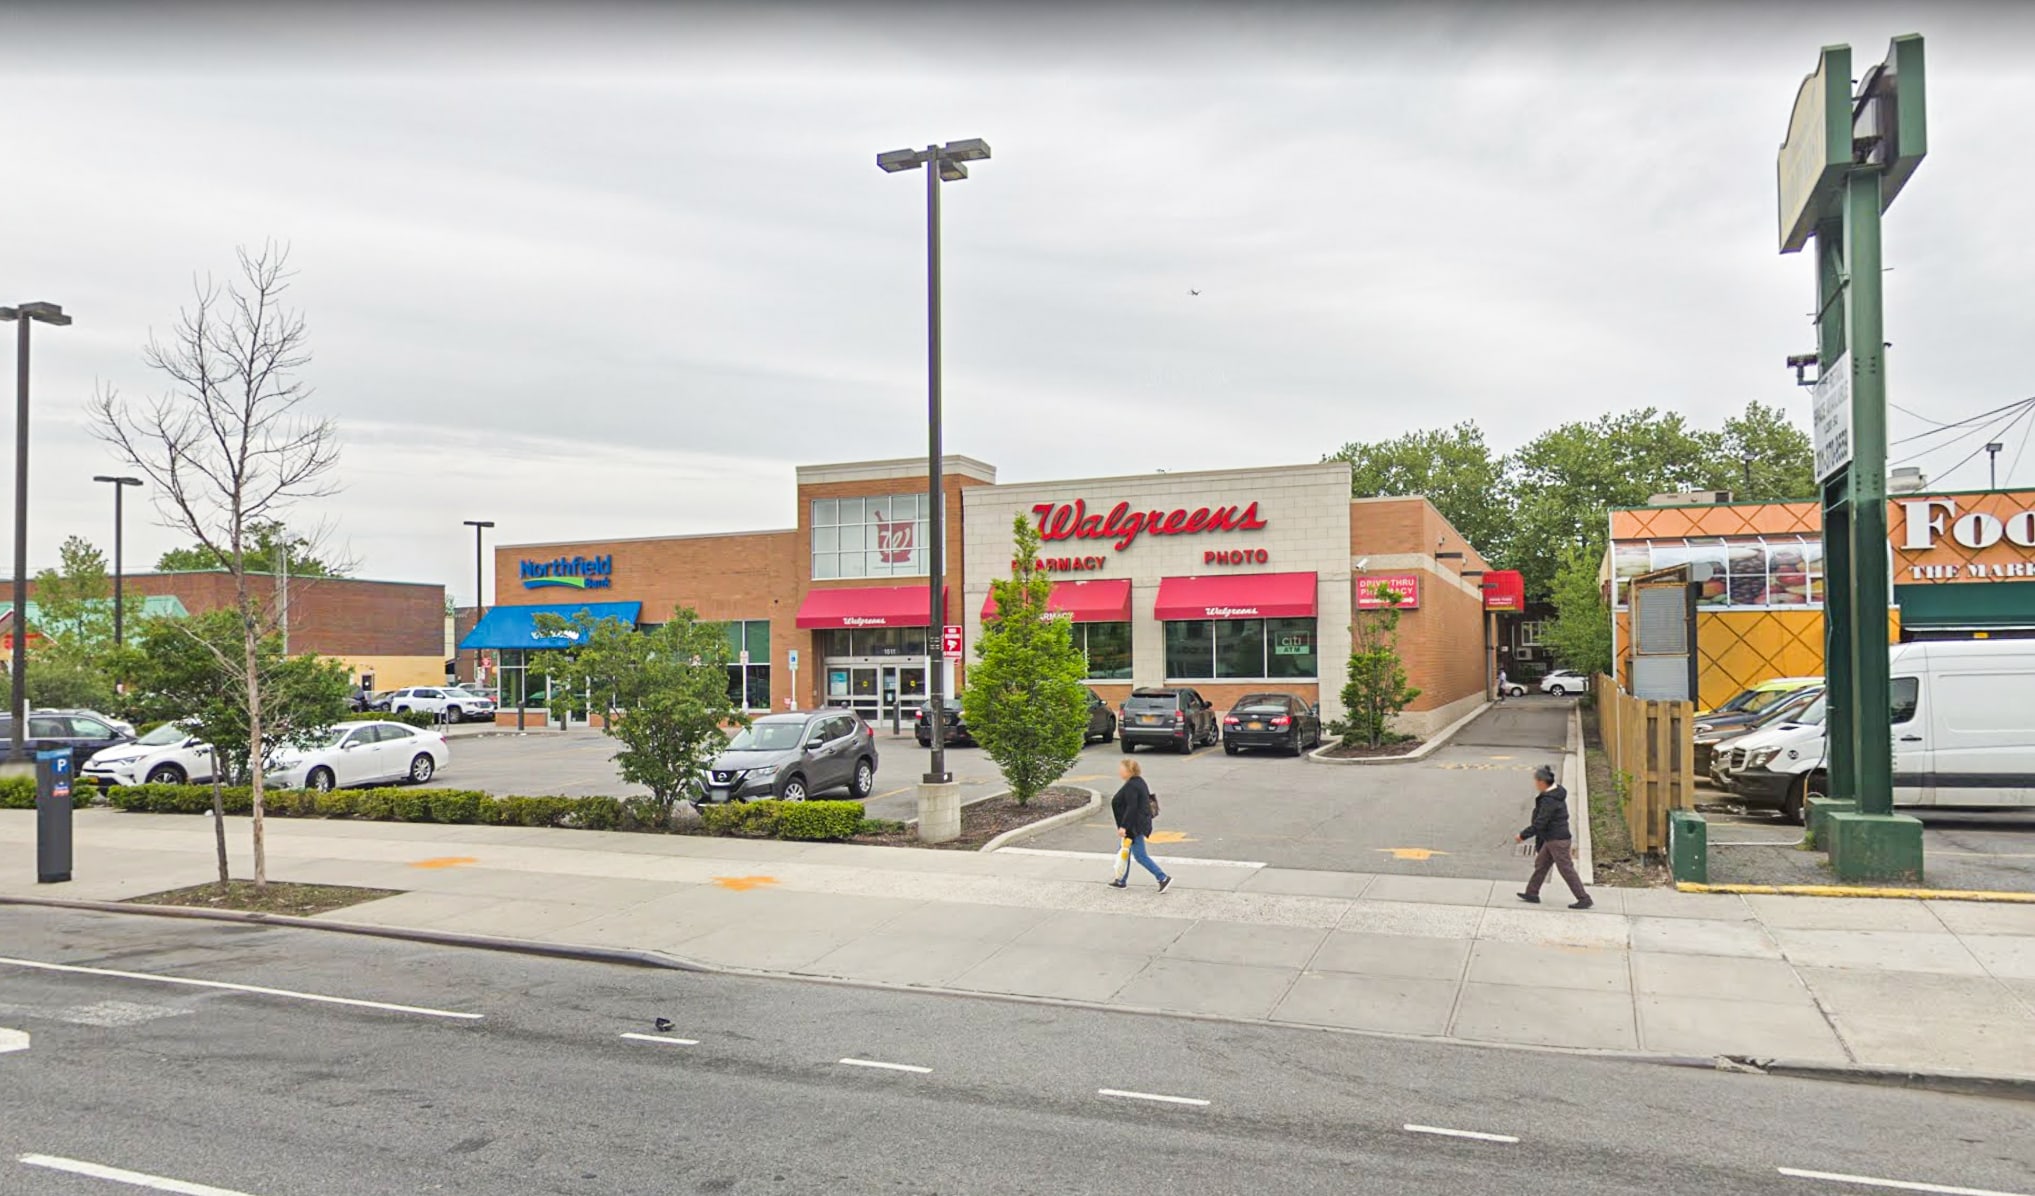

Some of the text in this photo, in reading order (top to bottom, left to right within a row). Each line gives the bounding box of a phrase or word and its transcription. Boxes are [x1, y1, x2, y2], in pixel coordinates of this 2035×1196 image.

[1032, 498, 1268, 551] Walgreens
[1011, 556, 1107, 573] PARMACY
[1203, 549, 1269, 565] PHOTO
[519, 554, 612, 579] Northfield
[1908, 565, 1959, 579] THE
[1204, 607, 1258, 618] Walgreens
[843, 617, 887, 627] Walgreens
[57, 758, 67, 772] P
